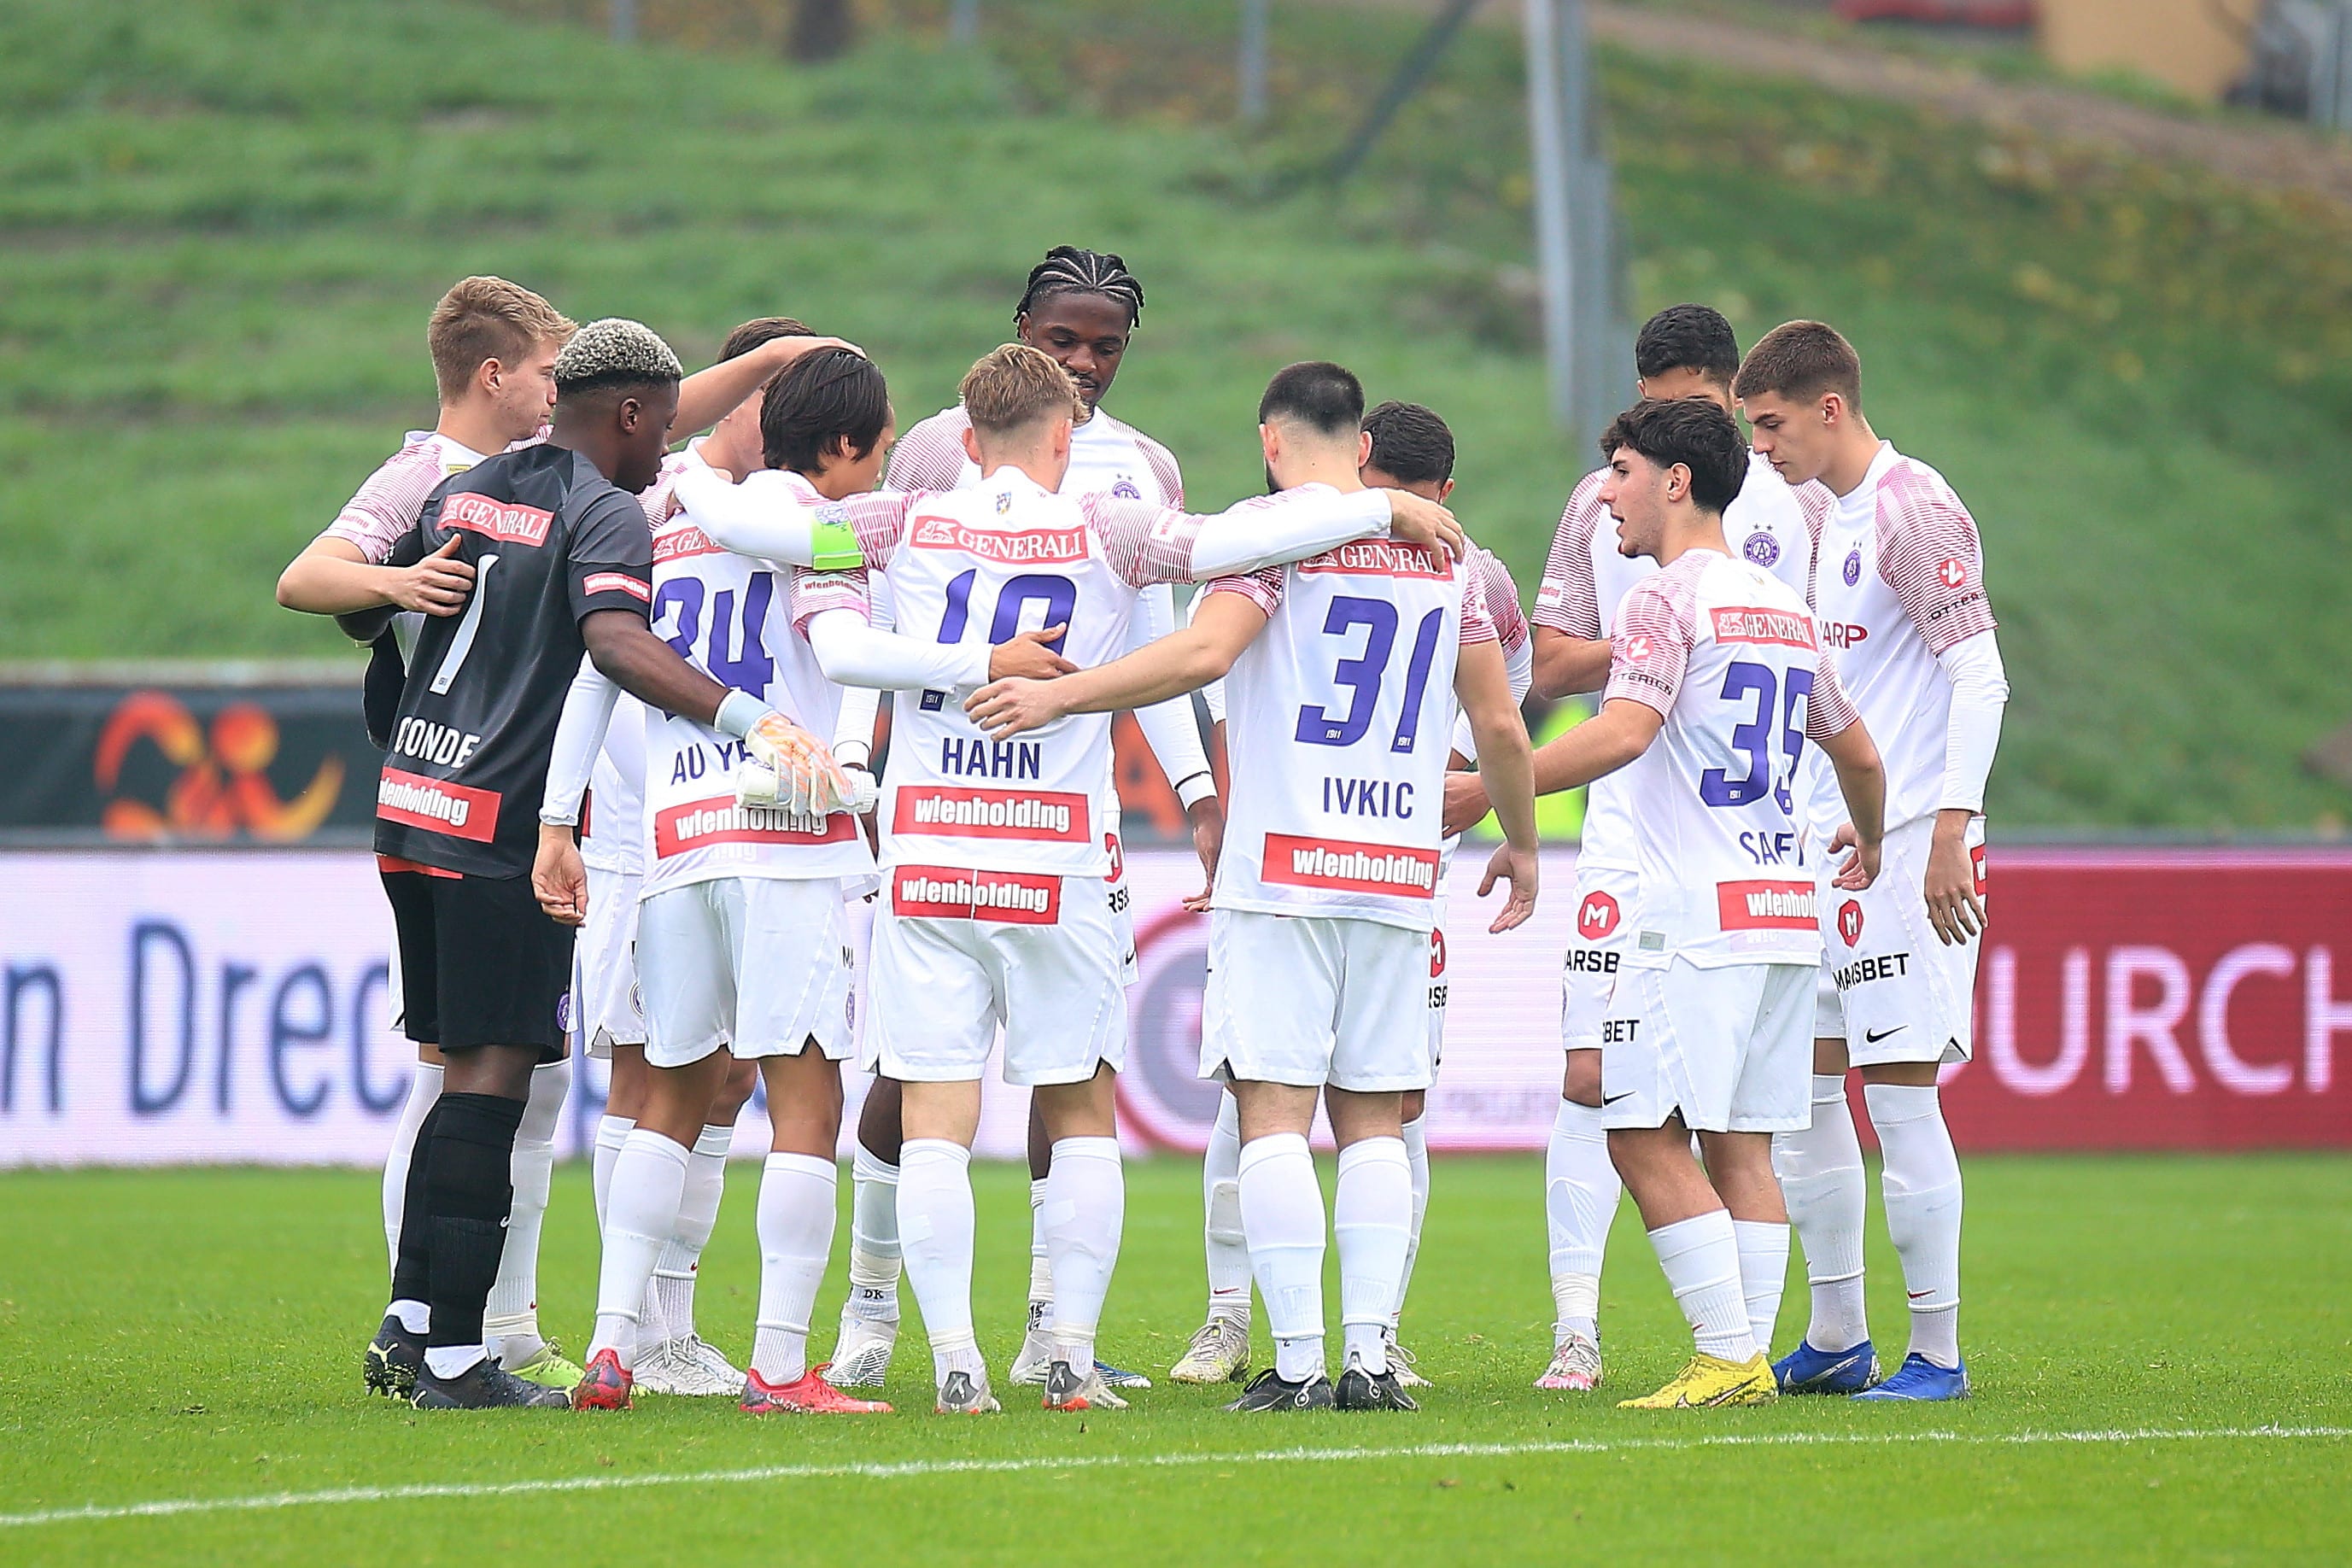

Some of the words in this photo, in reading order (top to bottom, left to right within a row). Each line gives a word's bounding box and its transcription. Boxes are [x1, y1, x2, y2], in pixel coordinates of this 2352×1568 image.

[958, 529, 1082, 560] GENERALI
[1340, 544, 1448, 576] GENERAL
[1820, 621, 1868, 649] ARP
[1295, 595, 1444, 753] 31
[394, 716, 482, 769] CONDE
[942, 736, 1040, 780] HAHN
[670, 742, 705, 786] AU
[1324, 776, 1414, 820] IVKIC
[1565, 949, 1621, 974] ARSB
[1603, 1019, 1641, 1044] BET
[1951, 943, 2352, 1097] URCH
[863, 1289, 884, 1300] DK
